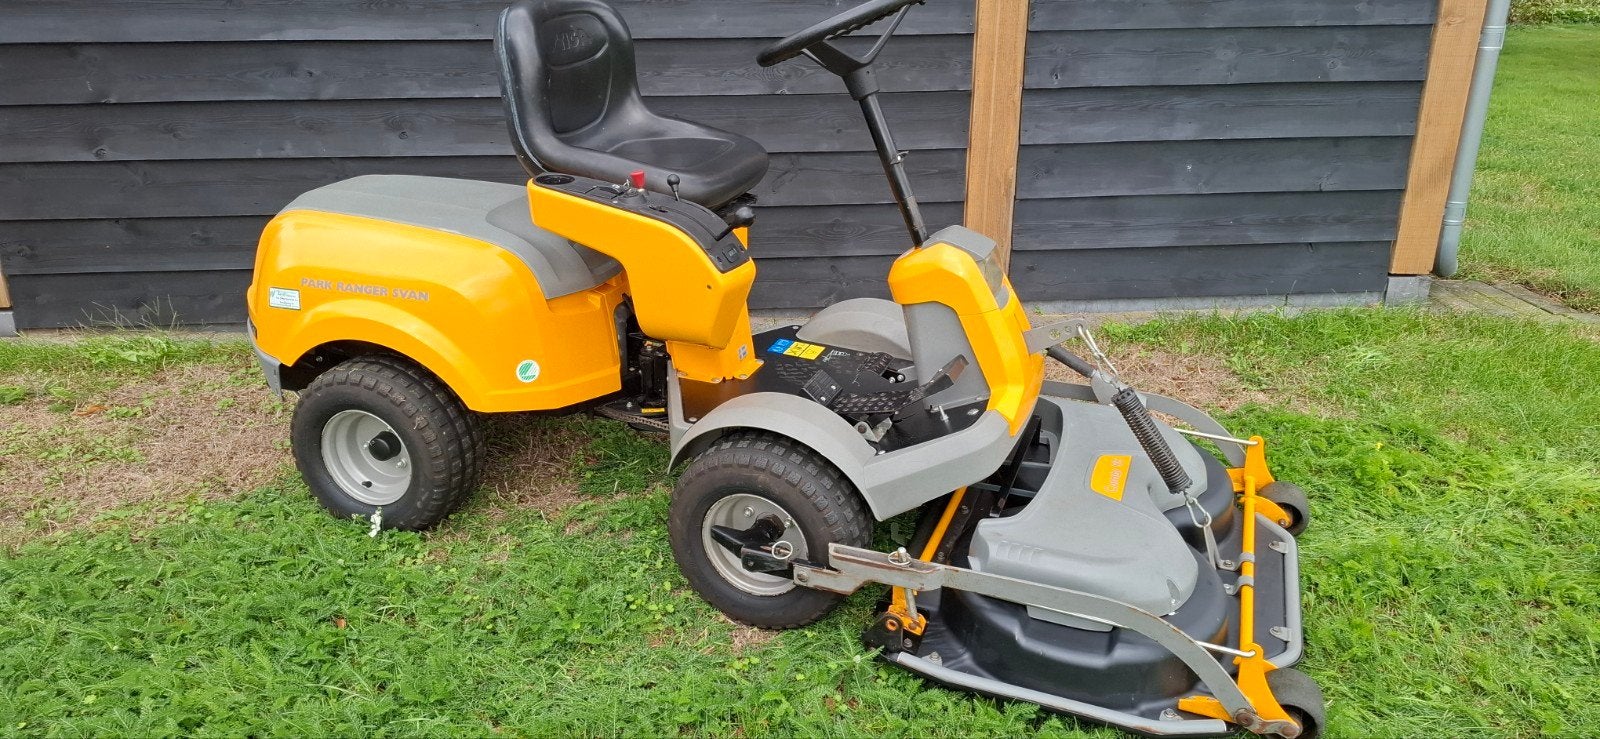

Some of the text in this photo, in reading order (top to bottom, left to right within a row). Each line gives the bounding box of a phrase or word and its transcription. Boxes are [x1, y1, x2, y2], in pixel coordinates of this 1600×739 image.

[300, 277, 430, 301] PARK RANGER SVAN
